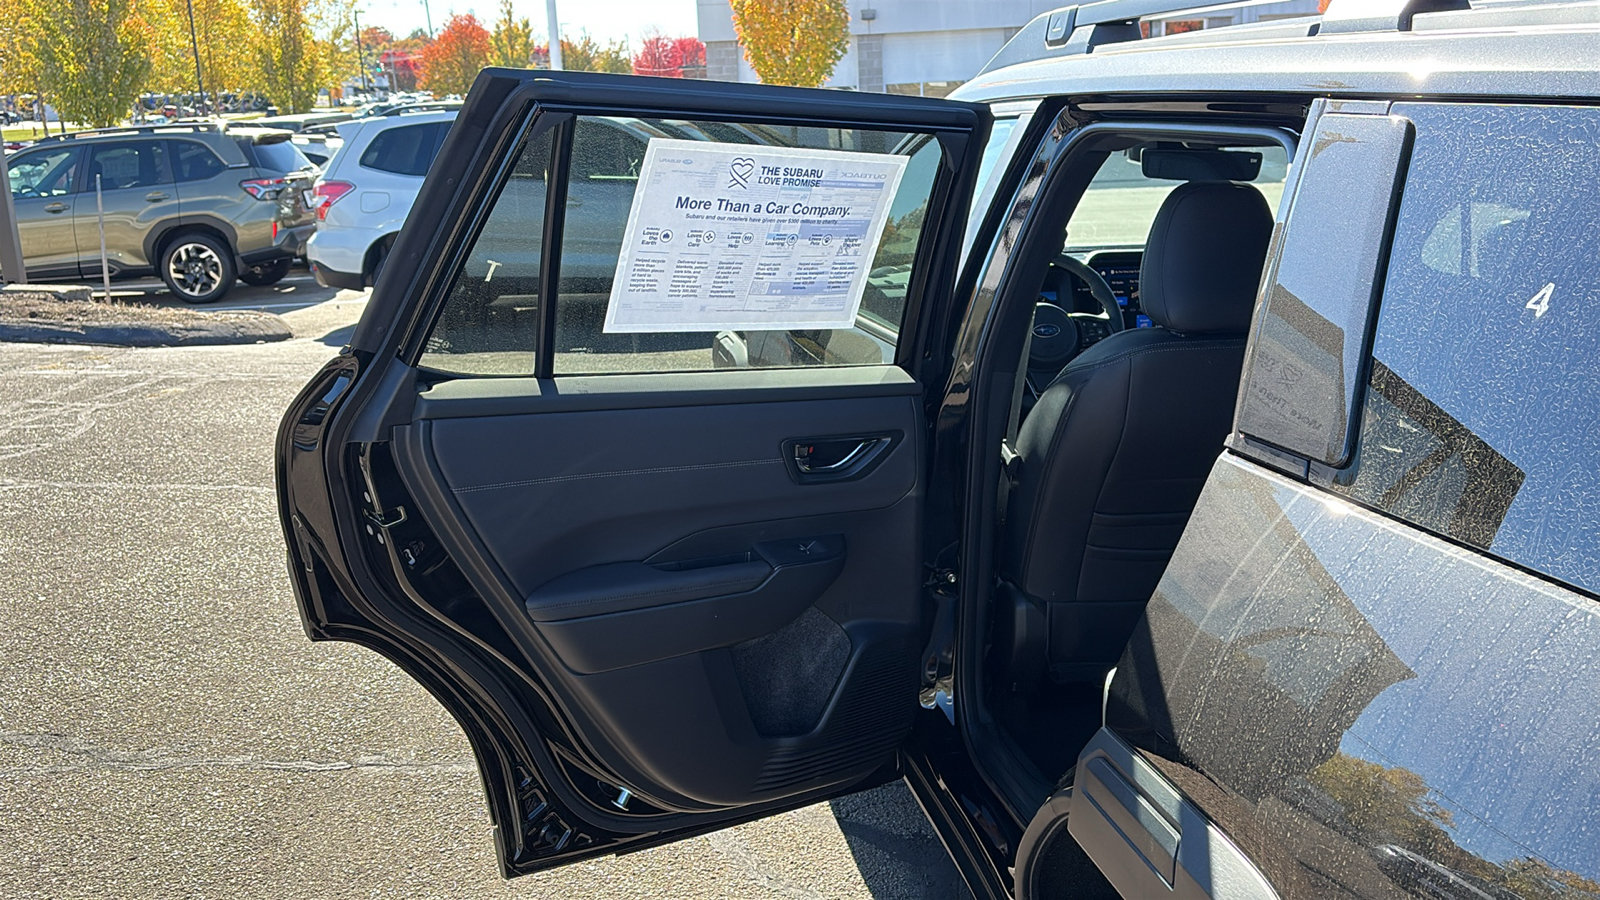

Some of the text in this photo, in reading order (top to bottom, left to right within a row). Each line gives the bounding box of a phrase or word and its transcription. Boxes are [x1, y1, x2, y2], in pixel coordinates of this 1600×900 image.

[761, 166, 824, 178] THE SUBARU
[758, 176, 781, 186] LOVE
[782, 178, 820, 188] PROMISE
[676, 196, 851, 217] More Than a Car Company.
[1526, 282, 1555, 318] 4
